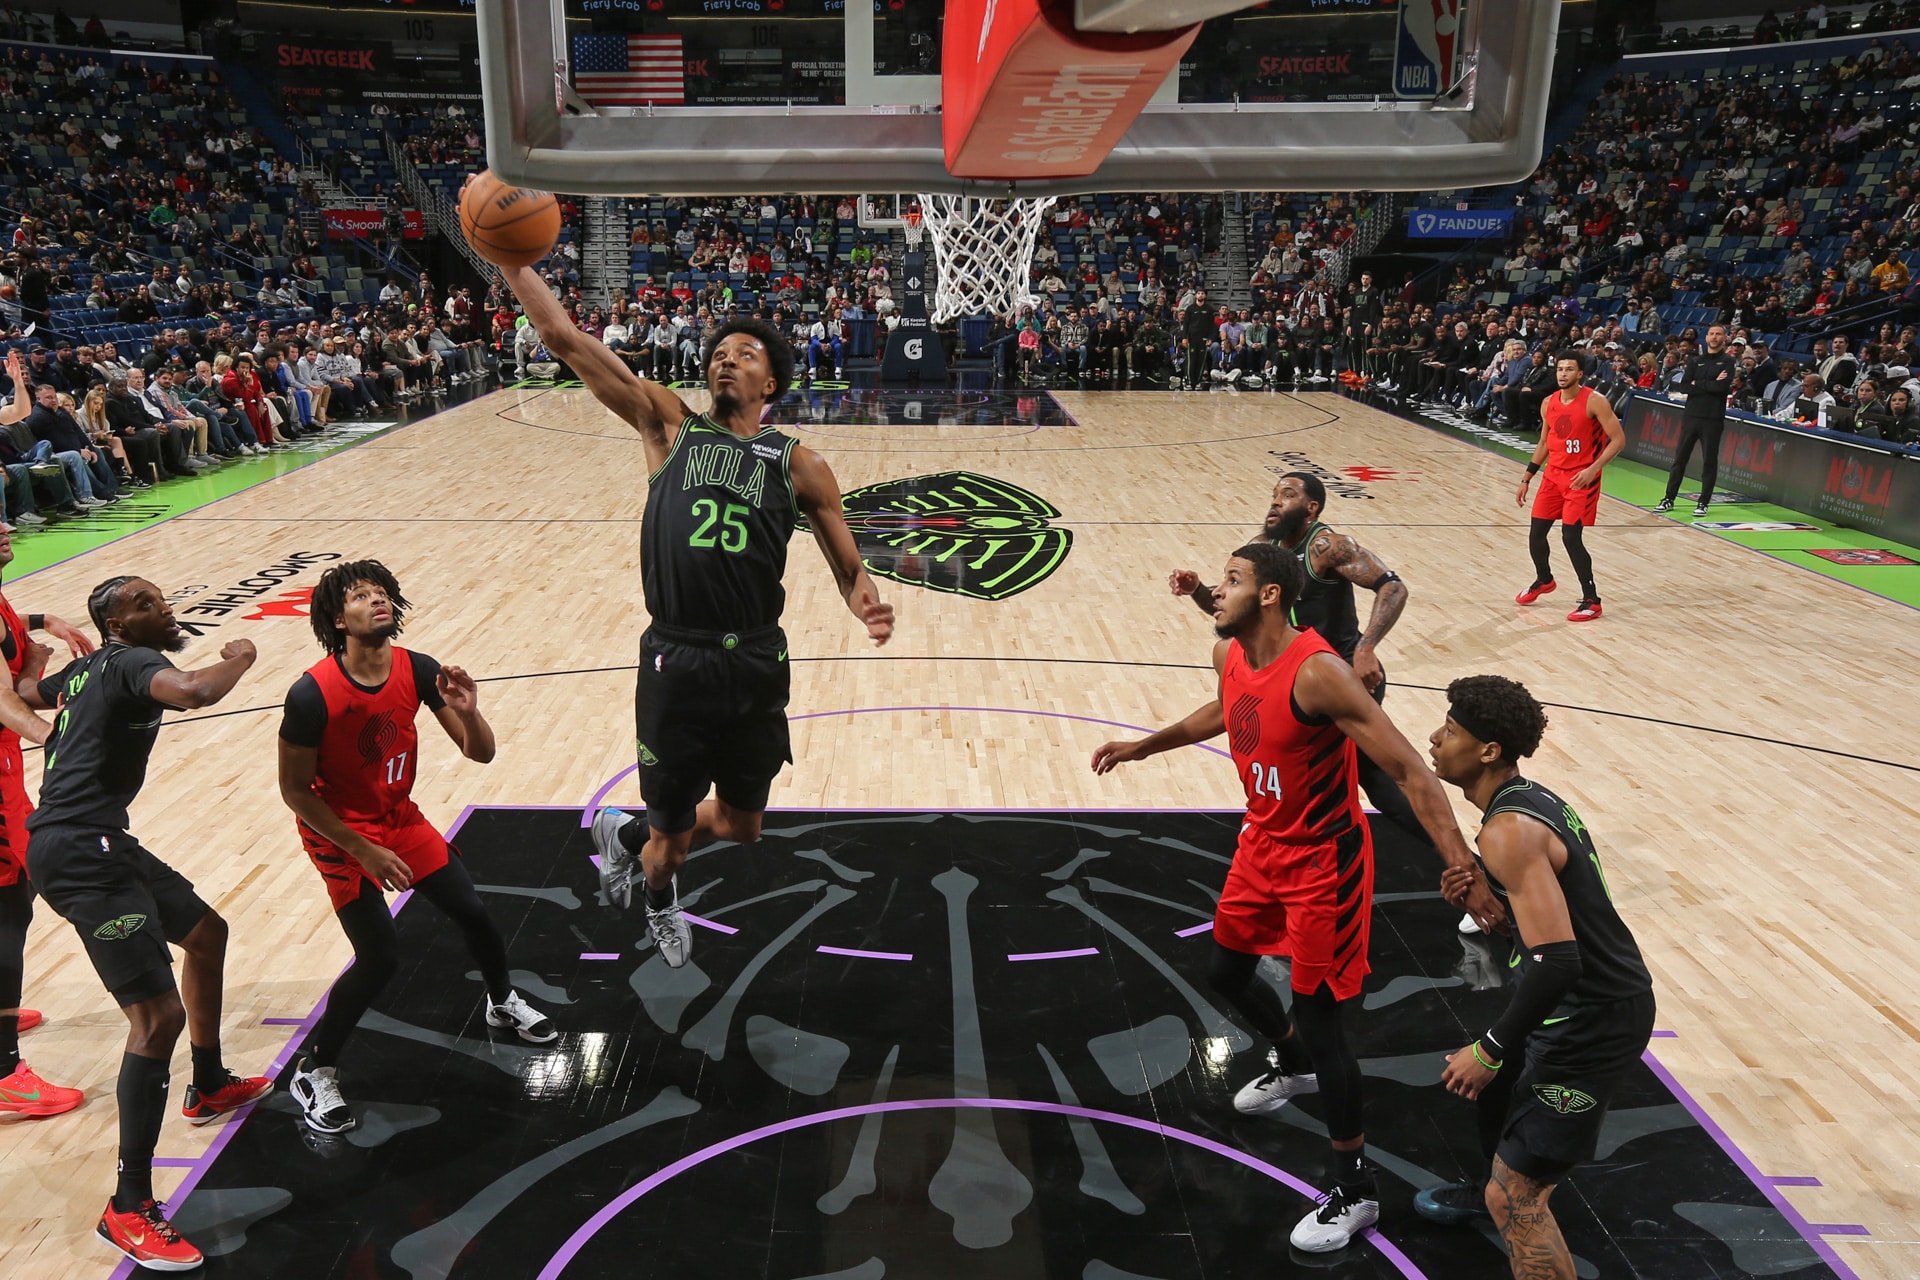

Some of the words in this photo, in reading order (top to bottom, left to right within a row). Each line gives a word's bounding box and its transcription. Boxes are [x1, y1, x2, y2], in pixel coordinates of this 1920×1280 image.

[825, 0, 845, 11] Fier
[403, 19, 434, 41] 105
[278, 44, 376, 71] SEATGEEK
[1260, 53, 1350, 76] SEATGEEK
[1402, 65, 1430, 90] NBA
[752, 442, 782, 456] NEWAGE
[1566, 439, 1580, 454] 33
[1722, 432, 1775, 476] NOLA
[682, 444, 766, 508] NOLA
[1826, 456, 1892, 508] NOLA
[1829, 506, 1860, 520] AMERICAN
[1861, 514, 1884, 526] SAFETY
[1836, 500, 1864, 512] ORLEANS
[689, 499, 750, 552] 25
[181, 552, 342, 618] SMOOTHIE
[386, 752, 408, 784] 17
[1252, 762, 1282, 800] 24
